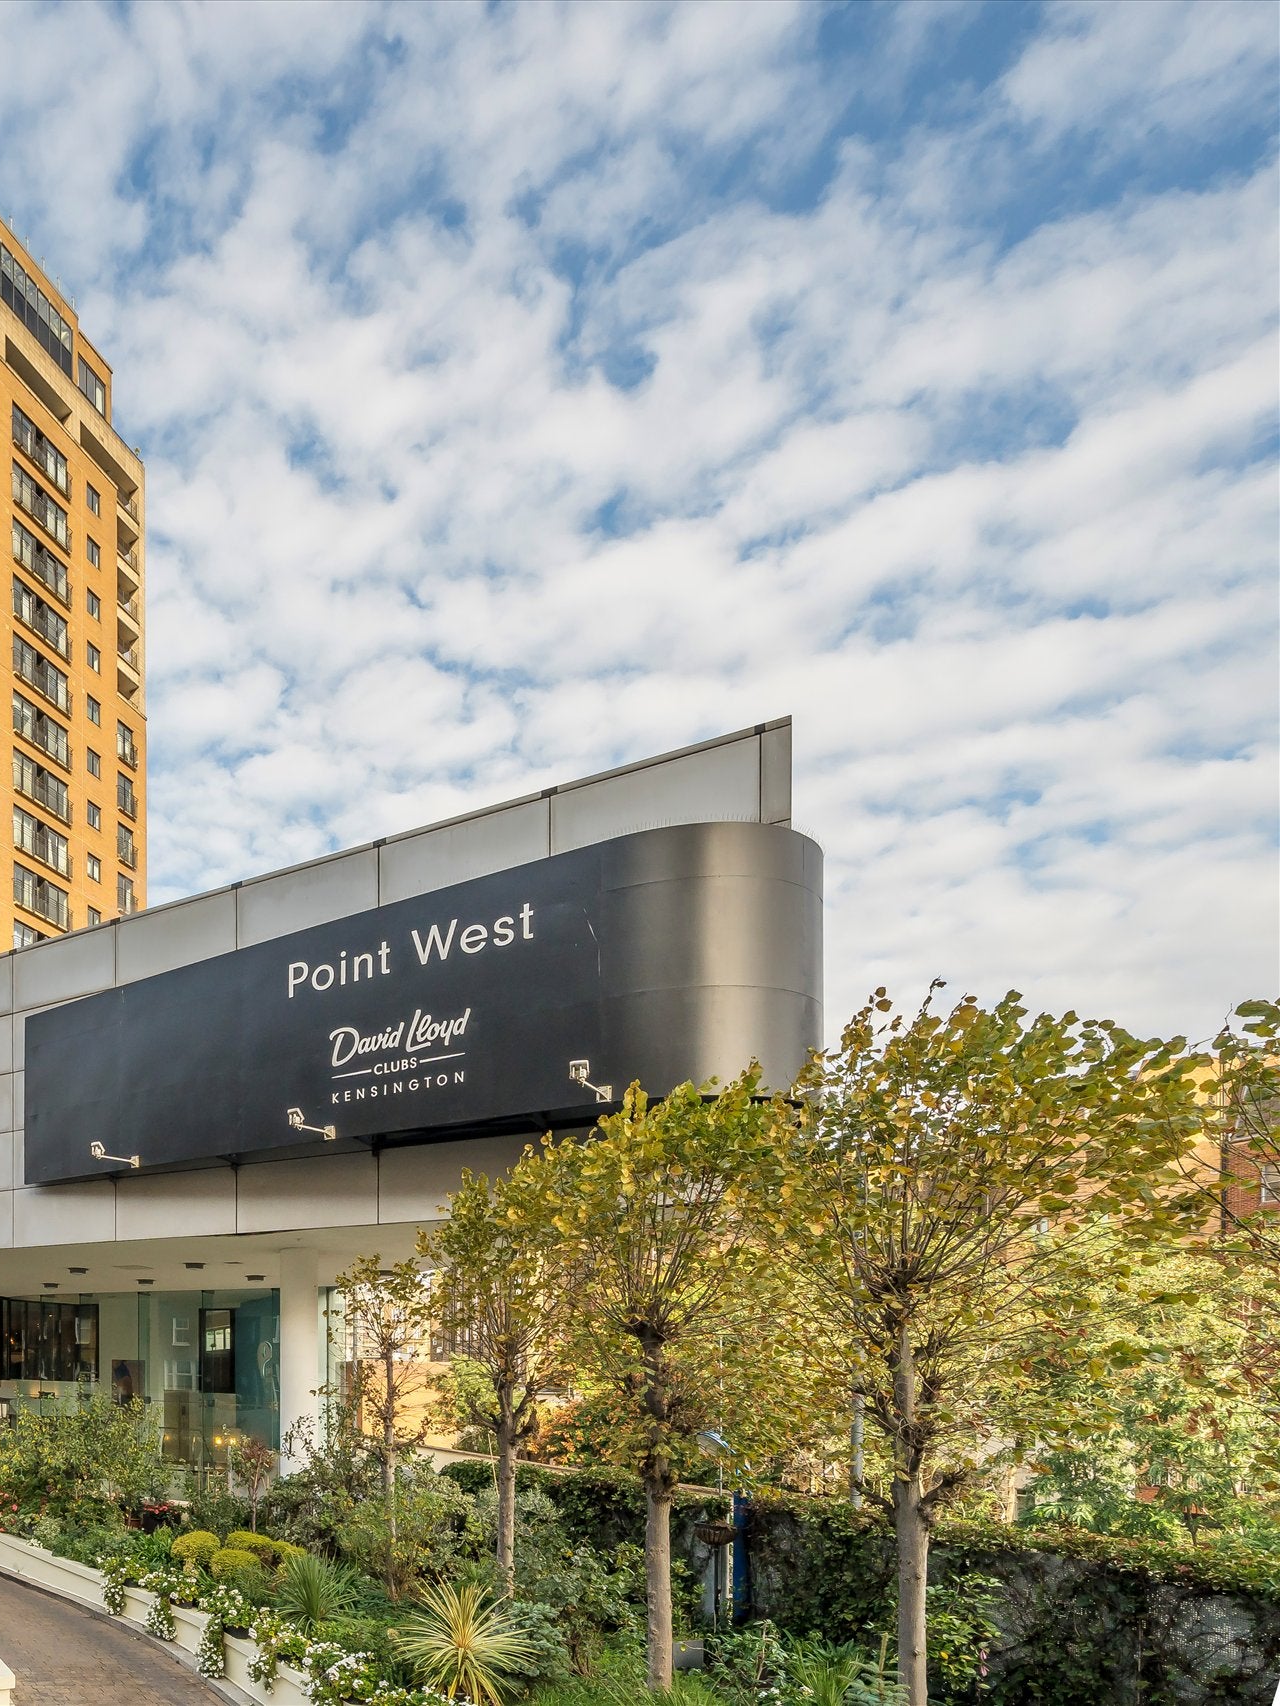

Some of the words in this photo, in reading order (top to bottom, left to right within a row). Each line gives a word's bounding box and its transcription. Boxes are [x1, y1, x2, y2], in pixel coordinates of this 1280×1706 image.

[287, 941, 391, 999] Point
[411, 902, 535, 966] West
[329, 1022, 404, 1068] David
[405, 1008, 471, 1053] Lloyd
[331, 1071, 466, 1105] KENSINGTON
[373, 1057, 418, 1076] CLUBS
